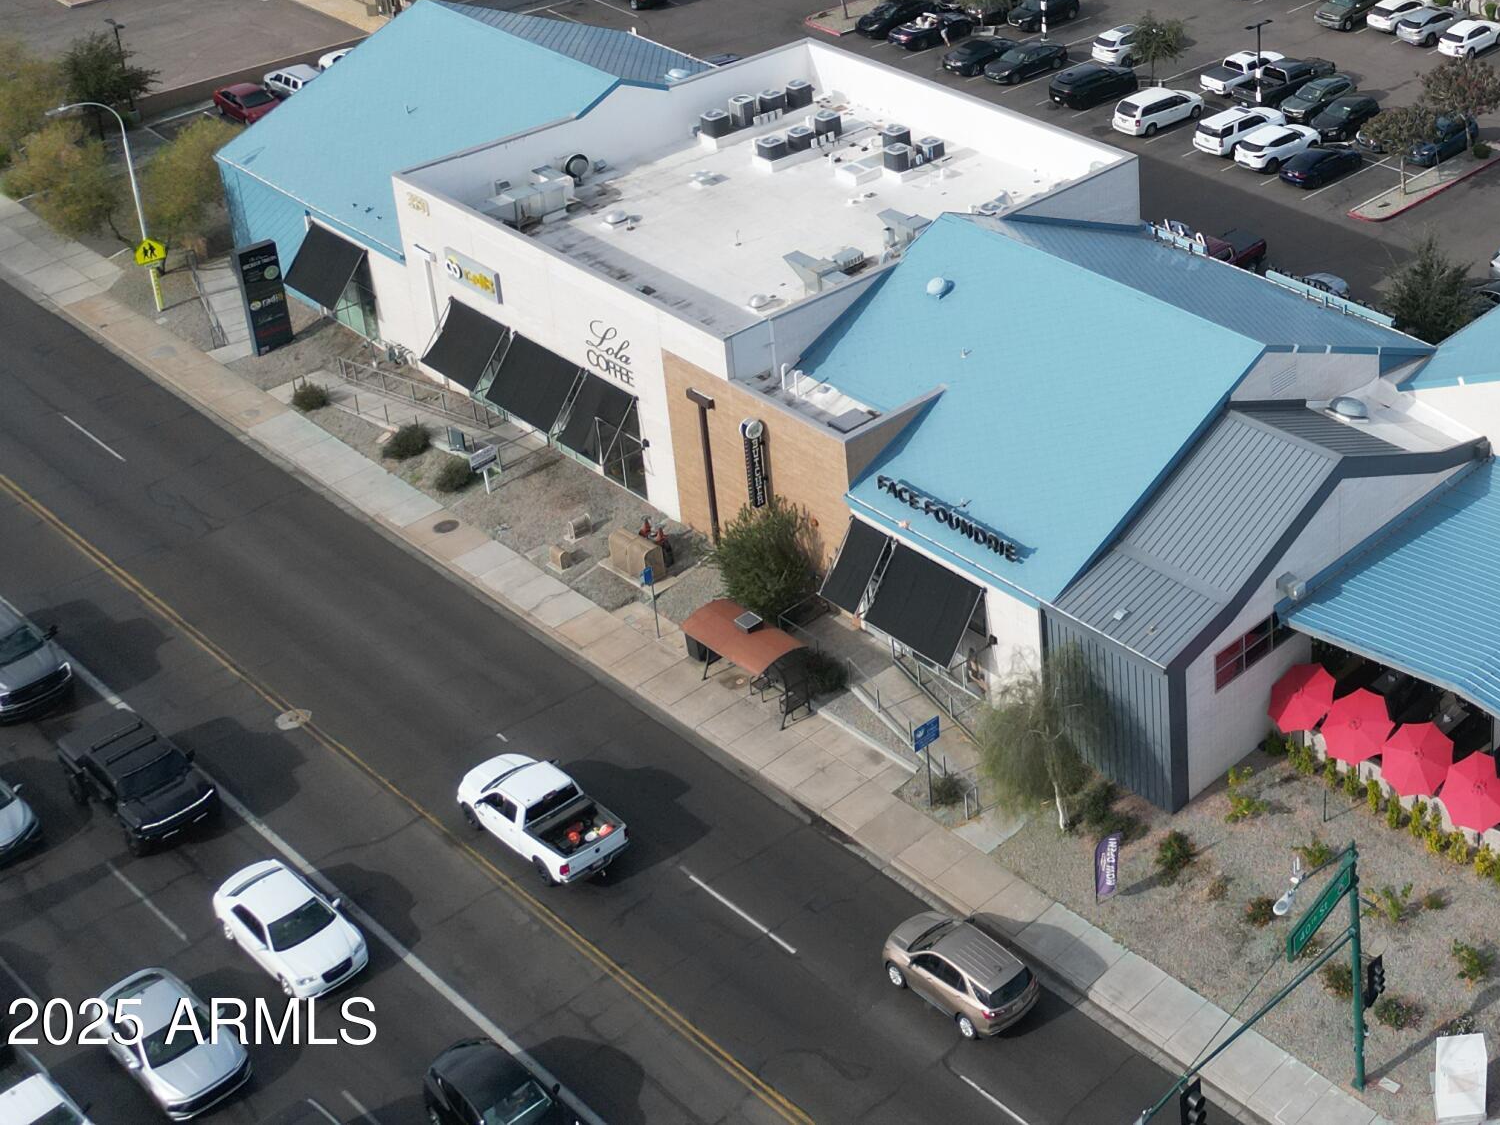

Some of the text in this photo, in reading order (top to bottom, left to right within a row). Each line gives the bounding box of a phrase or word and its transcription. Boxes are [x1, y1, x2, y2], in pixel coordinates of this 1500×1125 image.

[586, 320, 631, 365] Lola
[587, 349, 635, 388] COFFEE
[752, 439, 764, 506] BUTCHER
[877, 475, 1017, 563] FACE FOUNDRIE
[1106, 864, 1116, 886] NOW
